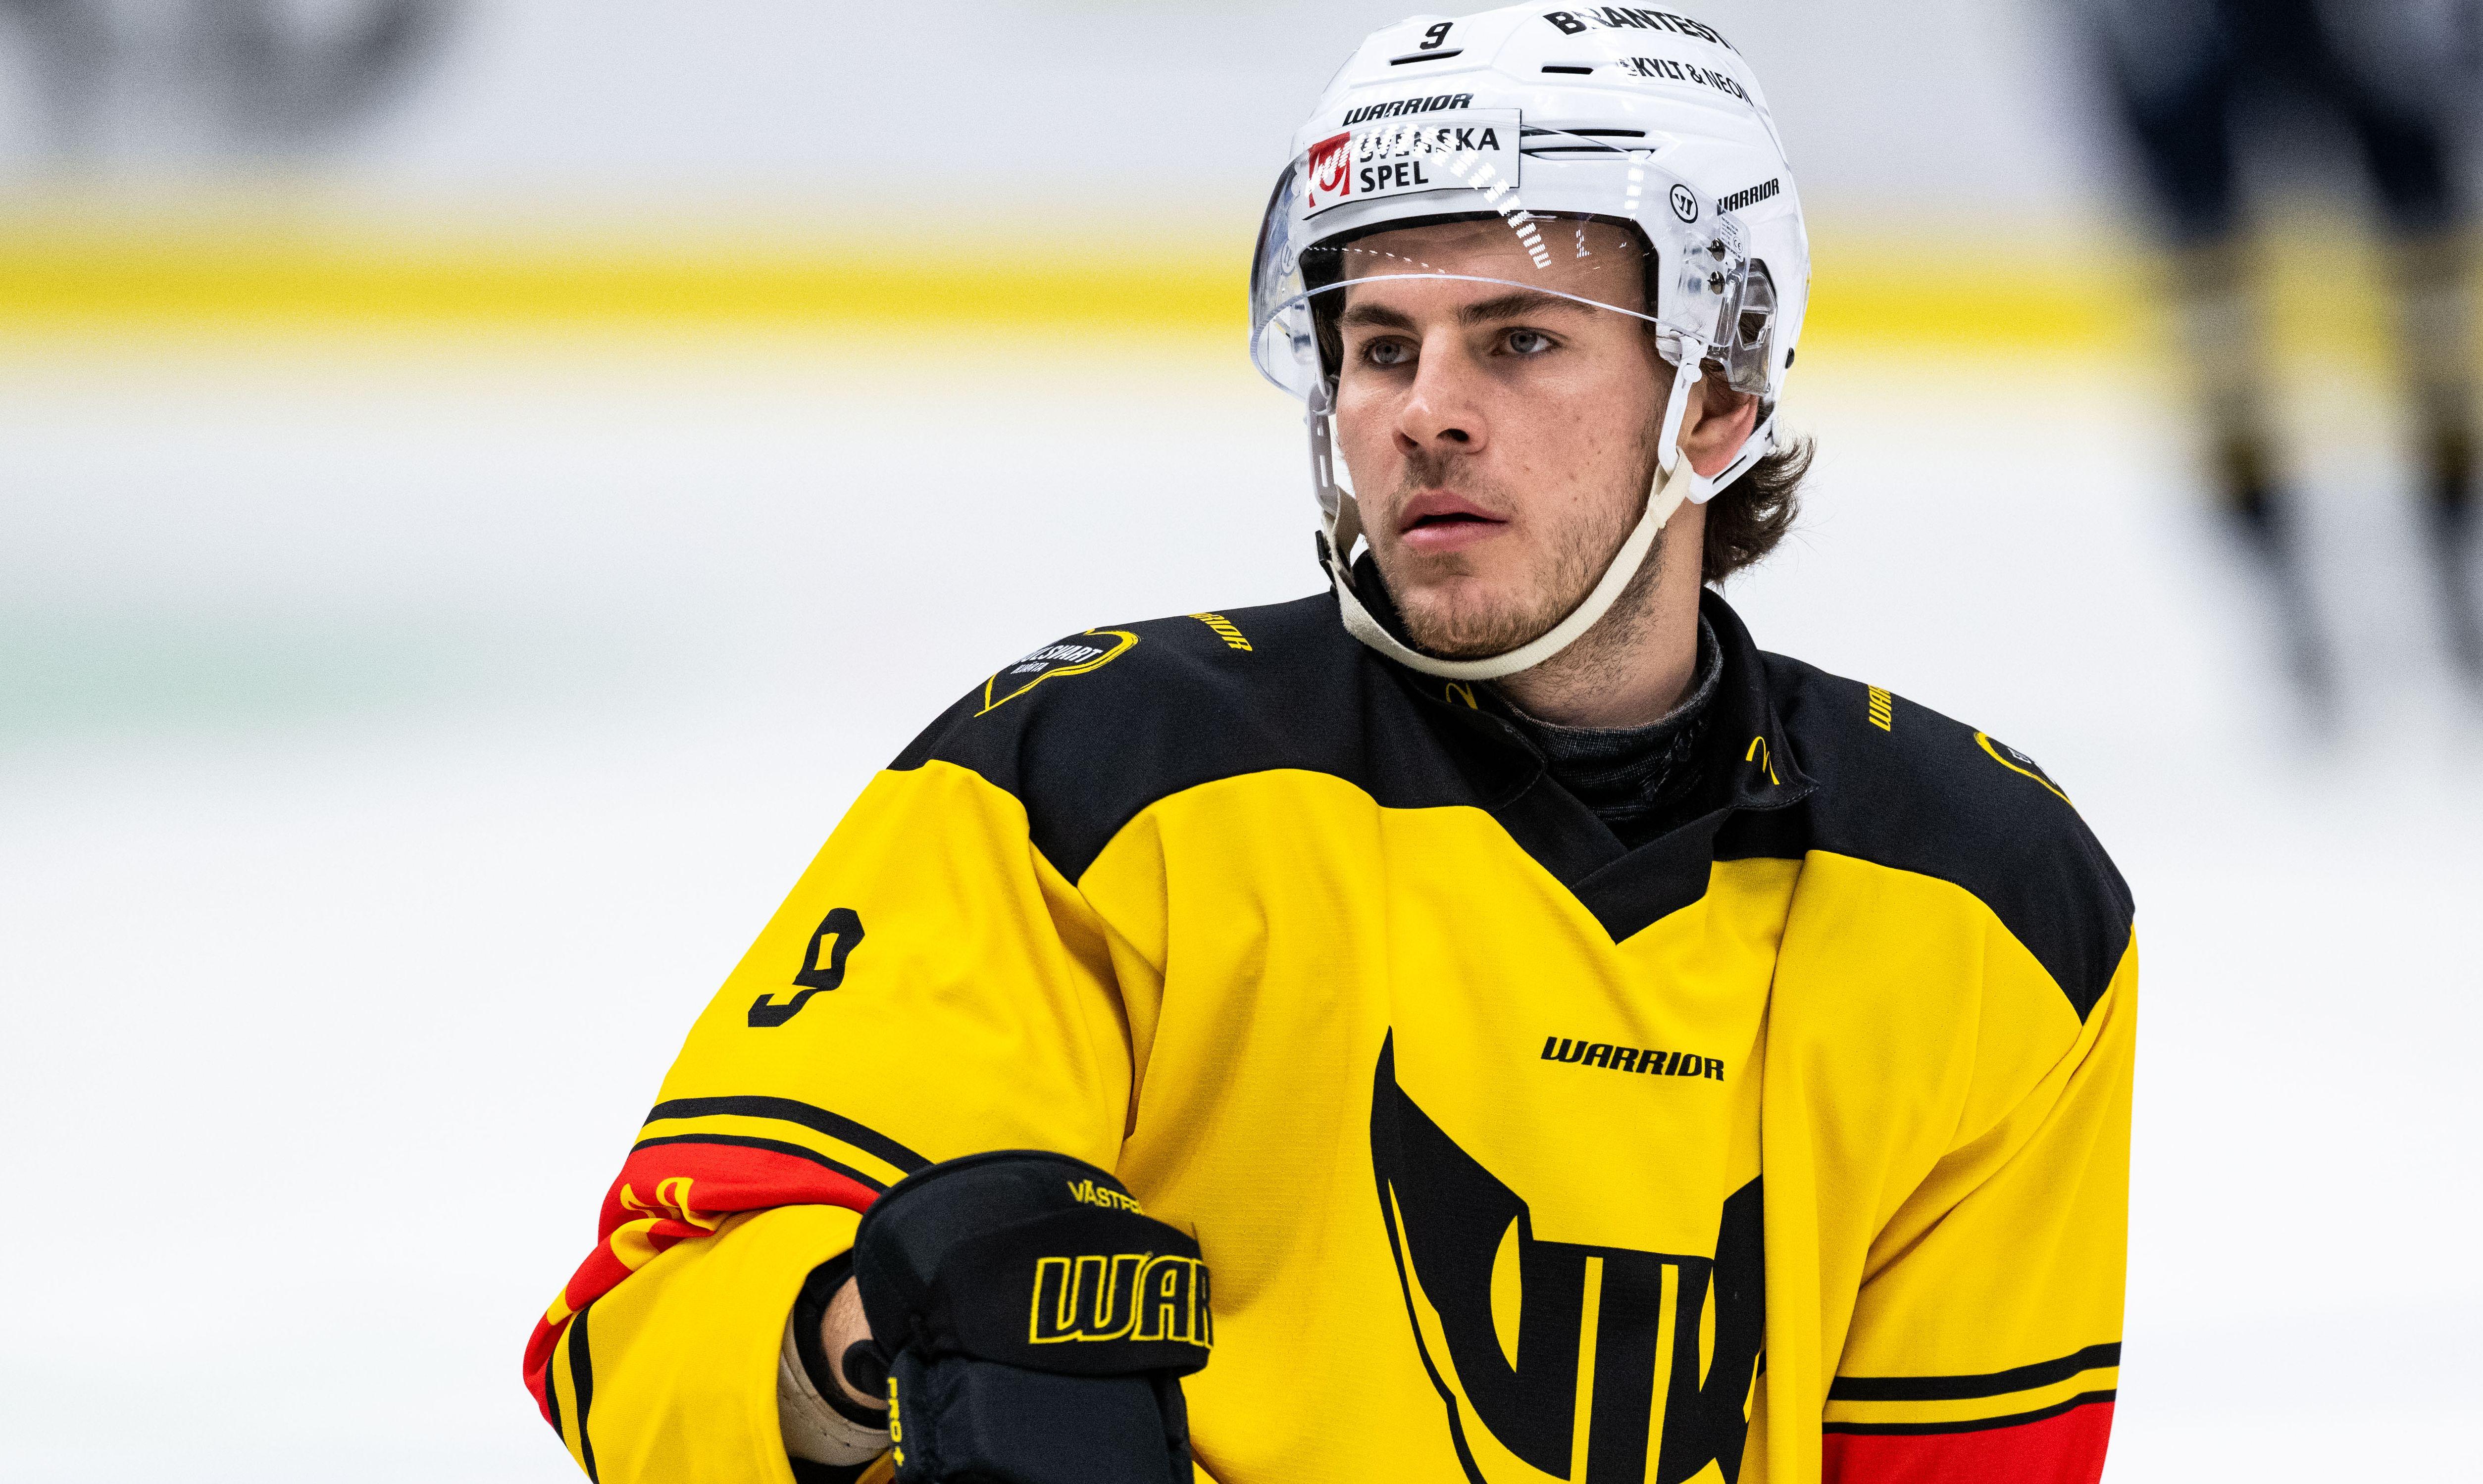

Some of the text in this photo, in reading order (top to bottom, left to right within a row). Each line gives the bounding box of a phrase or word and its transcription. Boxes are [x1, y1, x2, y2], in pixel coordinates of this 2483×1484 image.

[1419, 22, 1454, 50] 9
[1685, 63, 1707, 86] &
[1702, 68, 1755, 108] NEON
[1342, 93, 1474, 127] WARRIOR
[1360, 161, 1429, 193] SPEL
[1717, 178, 1780, 216] WARRIOR
[747, 907, 865, 1028] 9
[1541, 1036, 1724, 1082] WARRIOR
